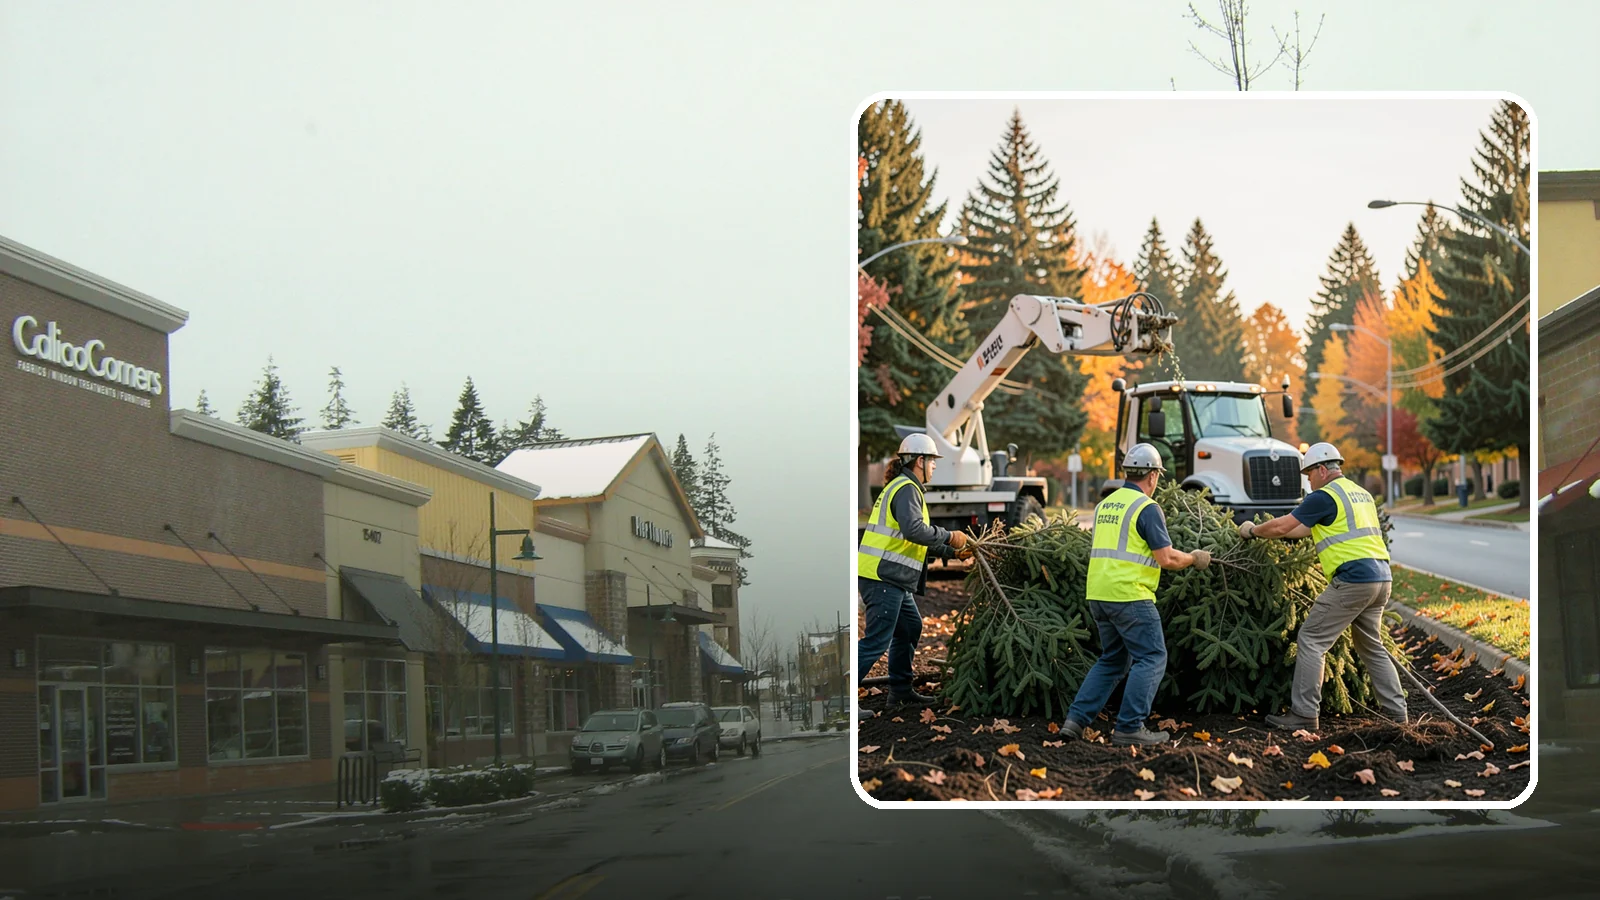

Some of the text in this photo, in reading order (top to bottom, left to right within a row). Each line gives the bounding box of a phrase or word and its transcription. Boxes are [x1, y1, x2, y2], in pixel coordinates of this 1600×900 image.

[17, 360, 151, 409] FABRICS WINDOW TREATMENTS FURNITURE
